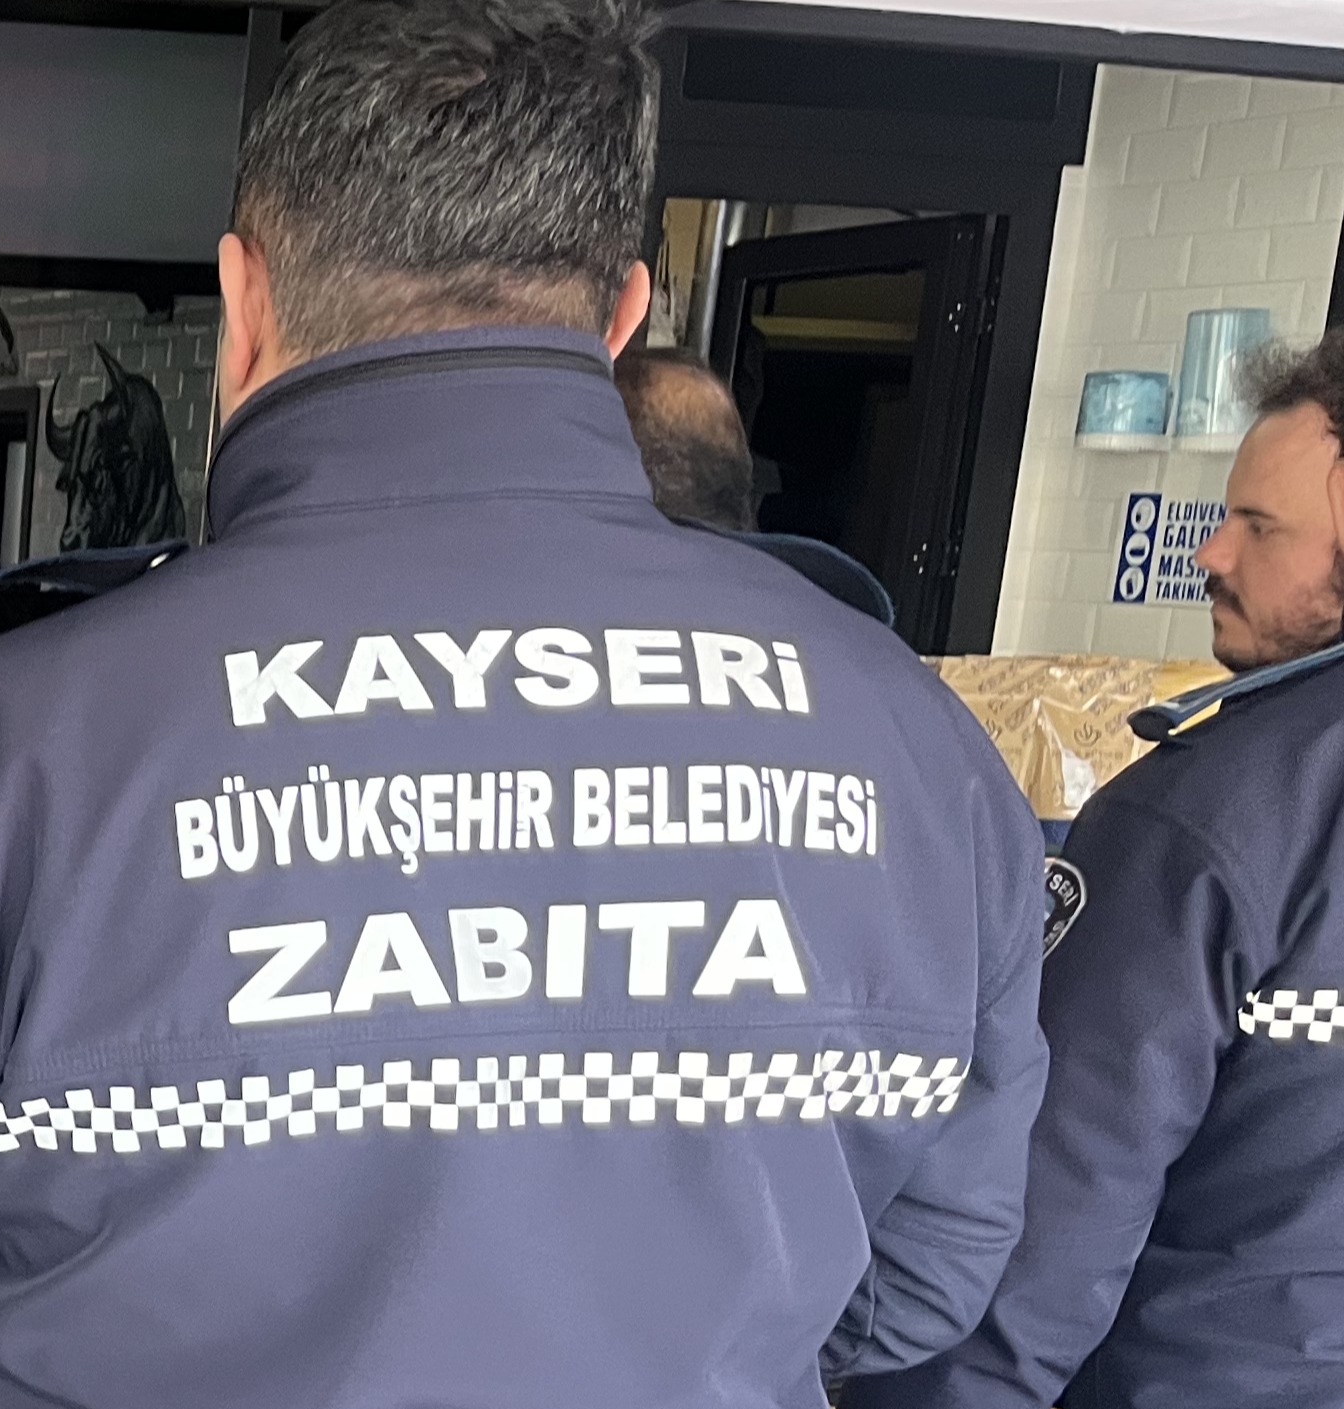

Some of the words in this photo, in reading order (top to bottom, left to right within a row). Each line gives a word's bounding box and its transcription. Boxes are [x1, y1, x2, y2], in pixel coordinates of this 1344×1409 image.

[1163, 525, 1218, 549] GALO
[223, 626, 811, 727] KAYSERİ
[173, 764, 555, 879] BÜYÜKŞEHİR
[572, 763, 878, 857] BELEDİYESİ
[227, 898, 808, 1025] ZABITA
